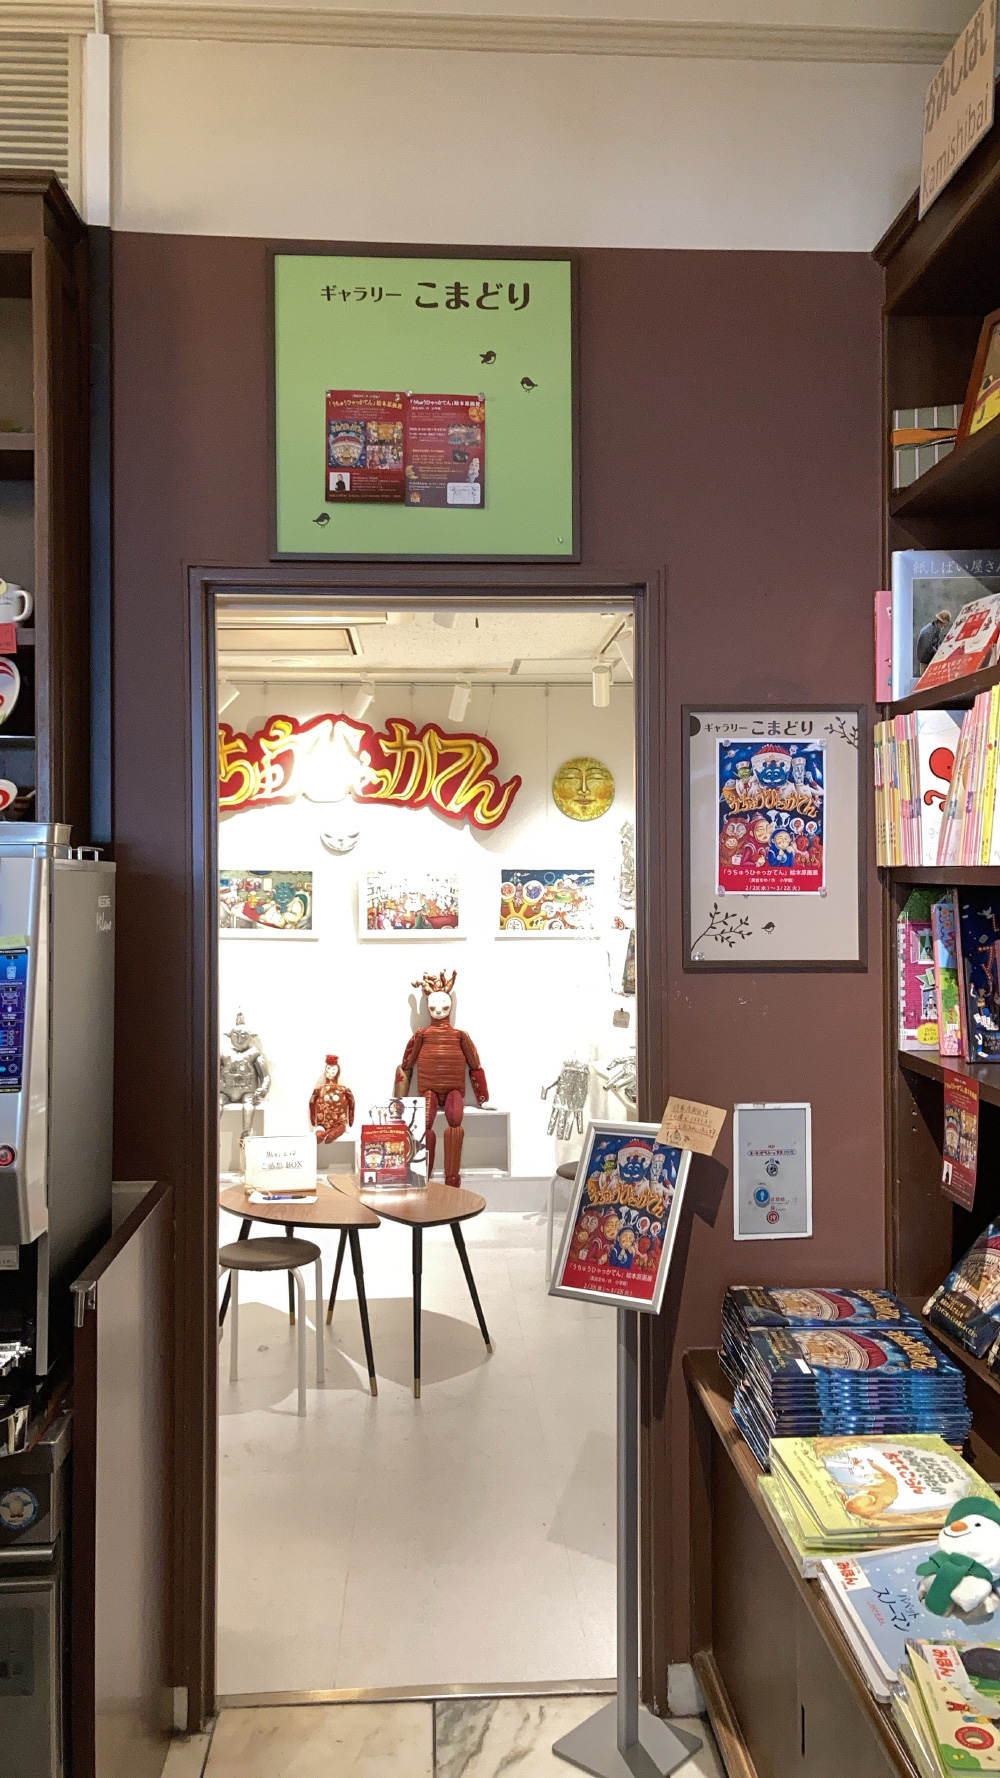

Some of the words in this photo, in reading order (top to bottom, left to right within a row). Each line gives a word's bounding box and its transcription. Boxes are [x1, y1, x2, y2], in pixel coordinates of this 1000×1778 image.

[923, 82, 989, 199] Kamishibai
[320, 284, 402, 303] ギャラリー
[415, 281, 530, 311] こまどり
[704, 723, 748, 733] ギャラリー
[751, 720, 813, 736] こまどり
[919, 1456, 954, 1484] どんなに
[836, 1561, 858, 1586] みほん
[873, 1587, 910, 1632] スノーマン
[932, 1648, 956, 1678] みほん
